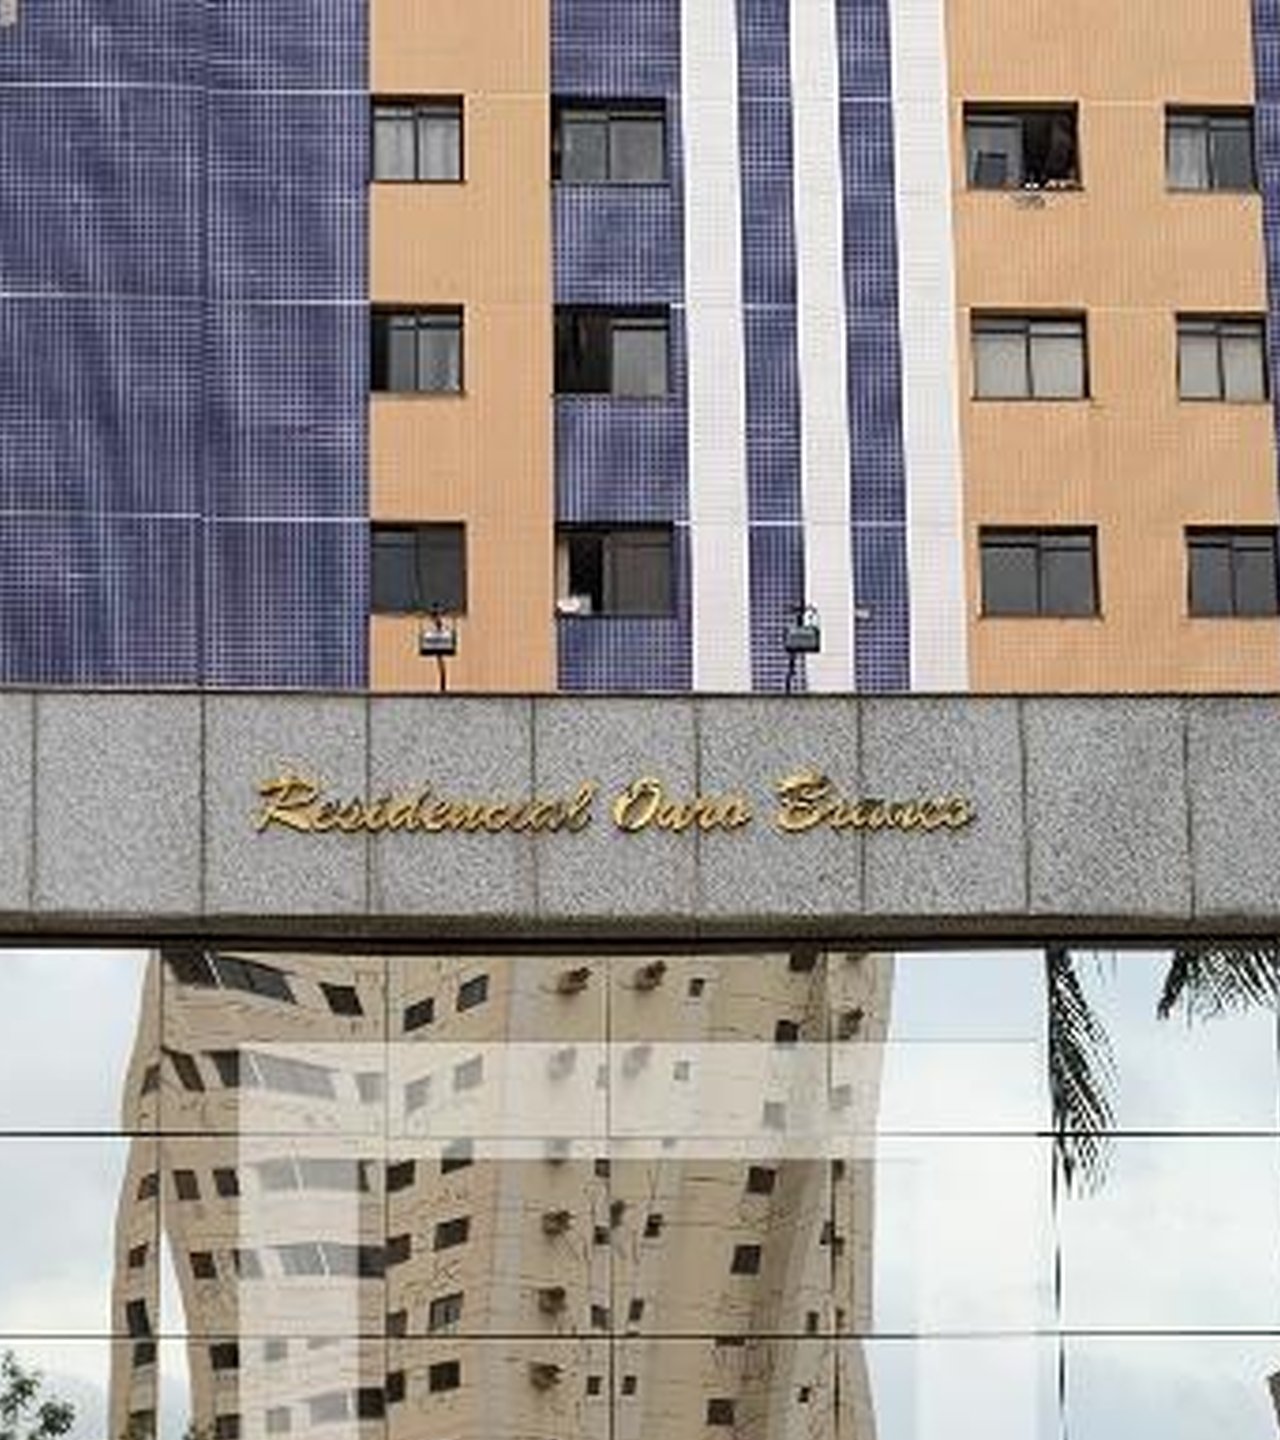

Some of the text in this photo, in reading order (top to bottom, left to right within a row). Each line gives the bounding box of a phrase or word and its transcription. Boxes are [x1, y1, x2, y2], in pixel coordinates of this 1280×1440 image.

[258, 767, 974, 834] Residencial Ouro Branco
